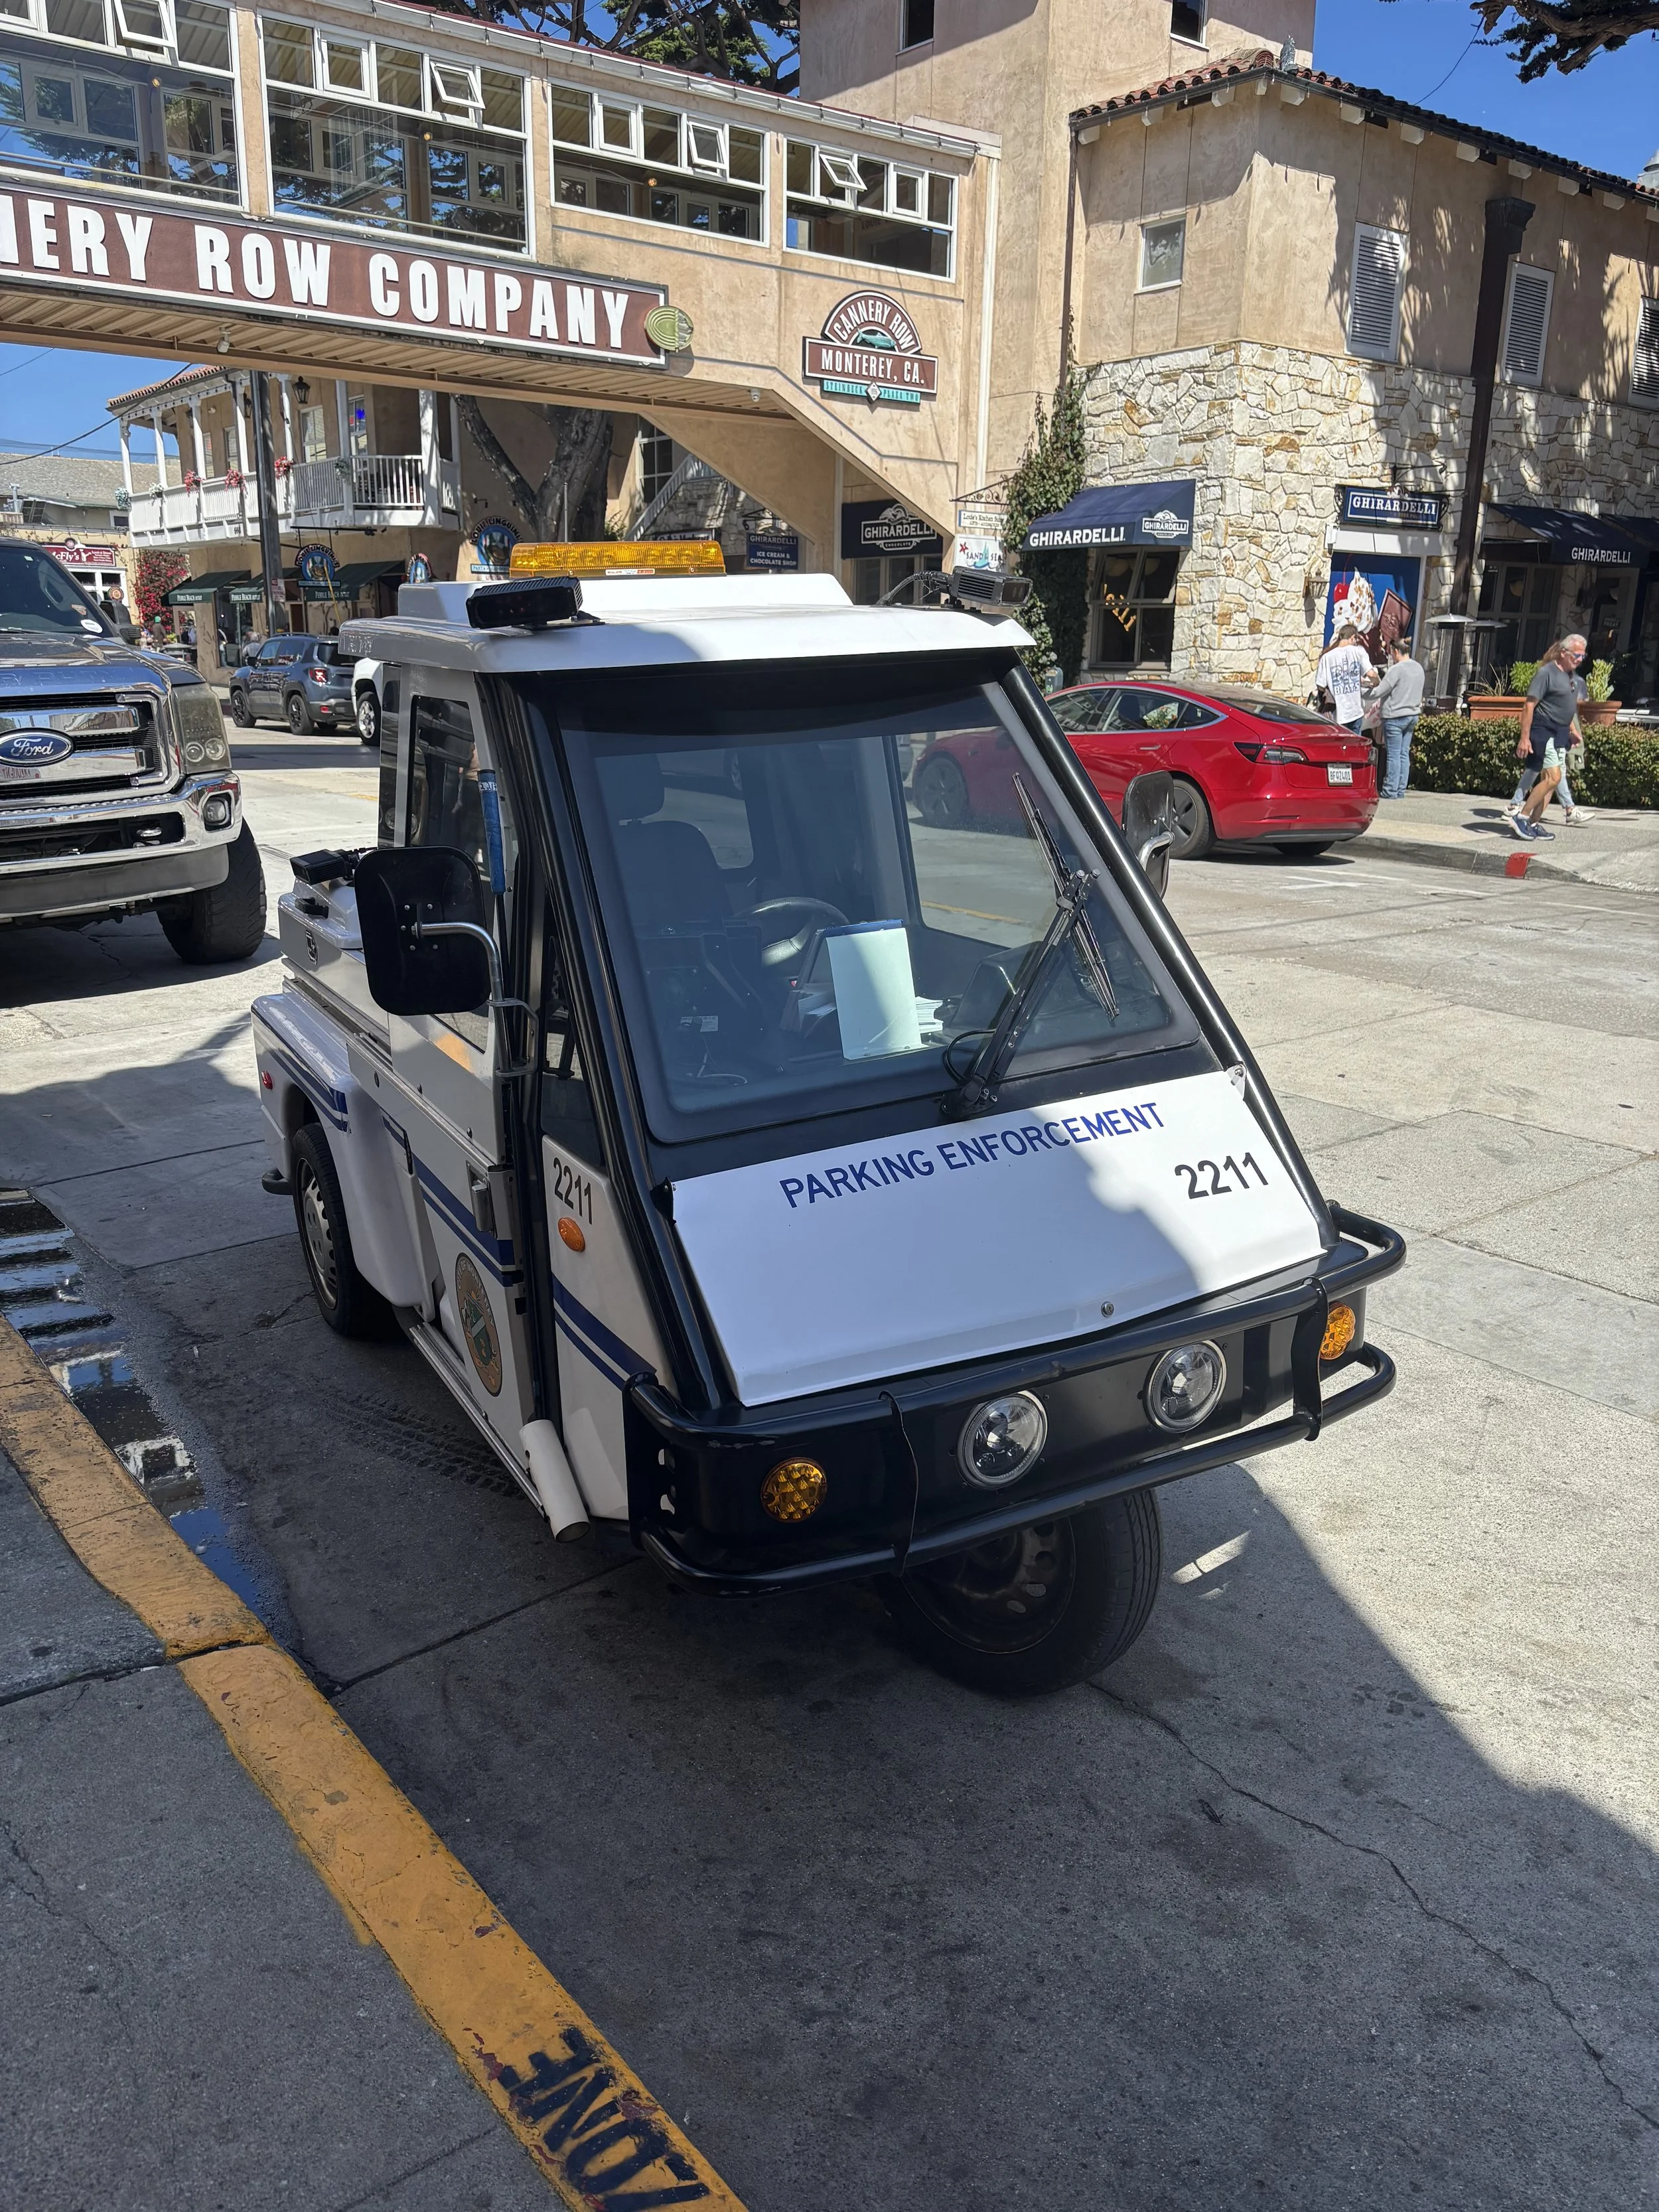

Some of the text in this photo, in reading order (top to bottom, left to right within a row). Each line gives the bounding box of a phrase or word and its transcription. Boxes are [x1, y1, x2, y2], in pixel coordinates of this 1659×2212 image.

[194, 224, 331, 307] ROW
[369, 253, 628, 350] COMPANY
[833, 299, 915, 350] CANNERY ROW
[821, 348, 925, 384] MONTEREY, CA.
[826, 381, 863, 394] STEINBECK
[883, 389, 918, 402] PLAZA TWO
[1352, 496, 1436, 515] GHIRARDELLI
[865, 523, 934, 539] GHIRARDELLI
[1145, 520, 1187, 531] GHIRARDELLI
[750, 536, 796, 545] GHIRARDELLI
[966, 552, 983, 560] SAND
[1571, 547, 1631, 563] GHIRARDELLI
[11, 737, 54, 757] Ford
[779, 1102, 1165, 1209] PARKING ENFORCEMENT
[1174, 1151, 1269, 1200] 2211
[553, 1157, 593, 1226] 2211
